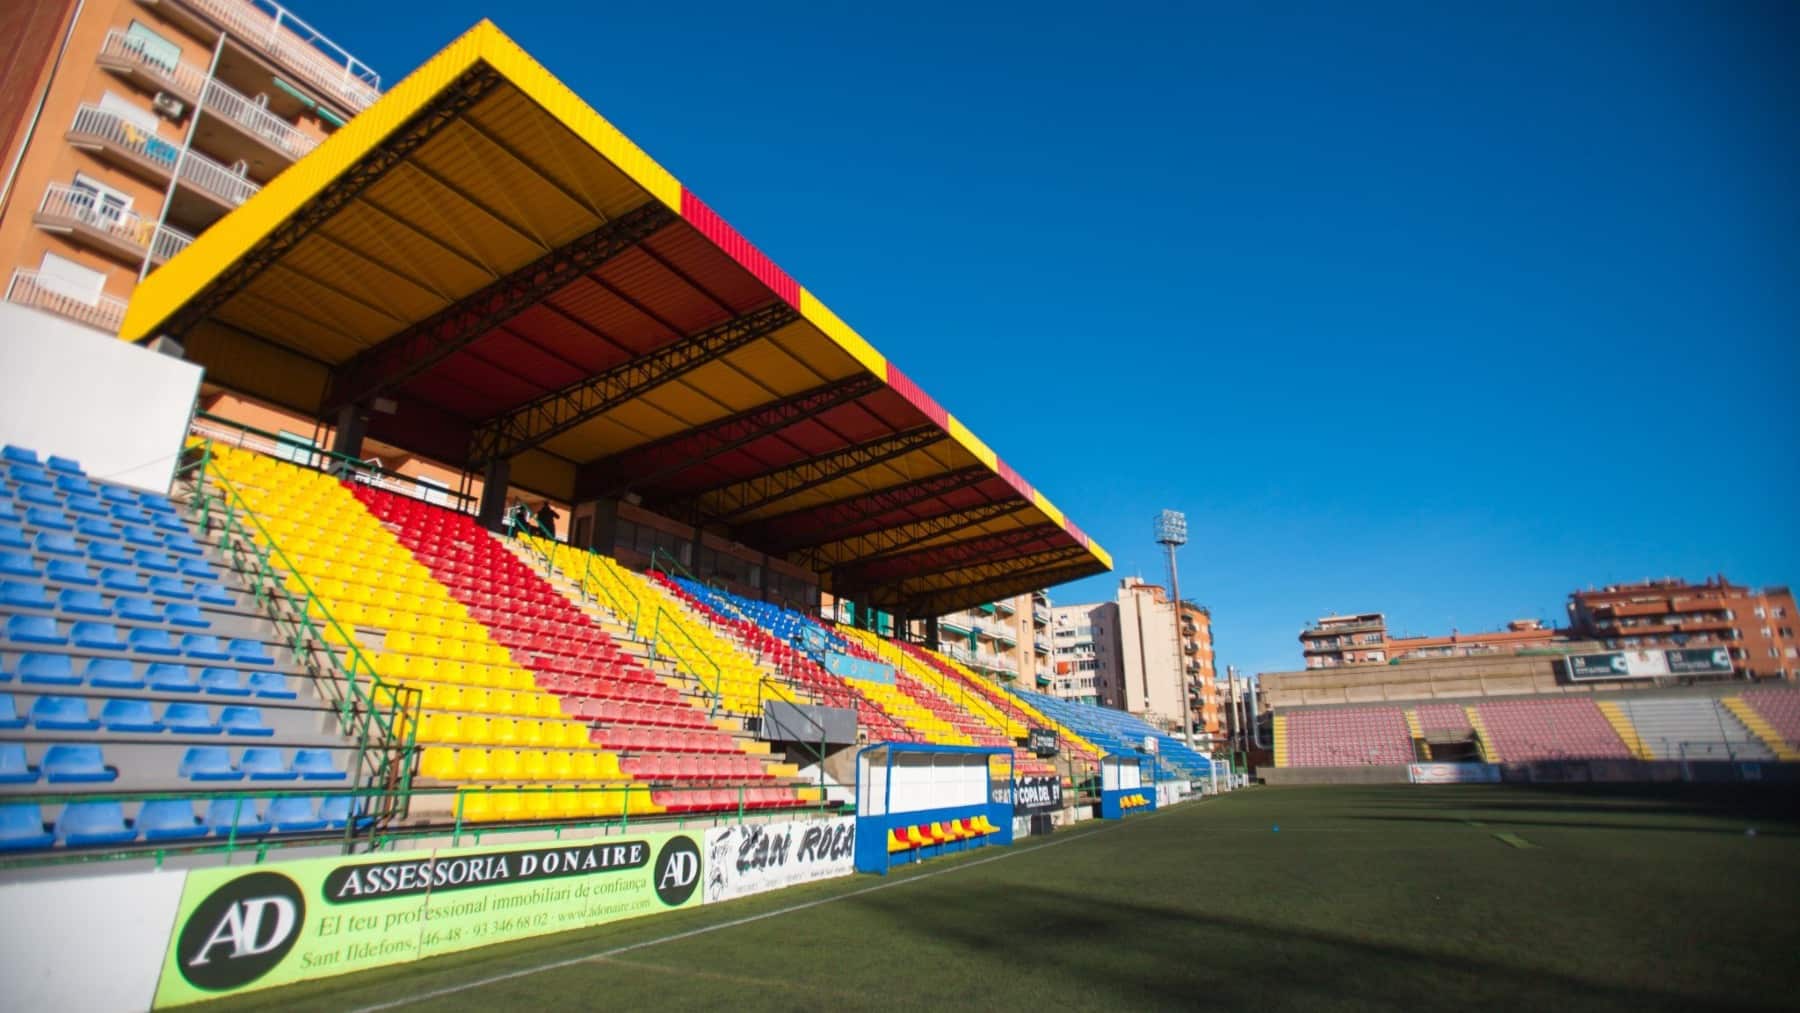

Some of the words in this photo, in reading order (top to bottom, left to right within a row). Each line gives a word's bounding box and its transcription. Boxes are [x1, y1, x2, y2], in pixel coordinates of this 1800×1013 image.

[1019, 786, 1039, 804] COPA
[797, 823, 855, 863] ROCA
[338, 857, 508, 897] ASSESSORIA
[519, 844, 642, 876] DONAIRE
[658, 850, 698, 890] AD
[188, 896, 296, 967] AD
[318, 914, 342, 937] El
[348, 915, 378, 933] teu
[383, 895, 488, 933] professional
[492, 887, 571, 911] immobiliari
[574, 883, 590, 898] de
[593, 877, 647, 895] confiança
[299, 951, 340, 970] Sant
[472, 922, 488, 937] 93
[492, 918, 514, 933] 346
[516, 915, 531, 929] 68
[532, 912, 549, 927] 02
